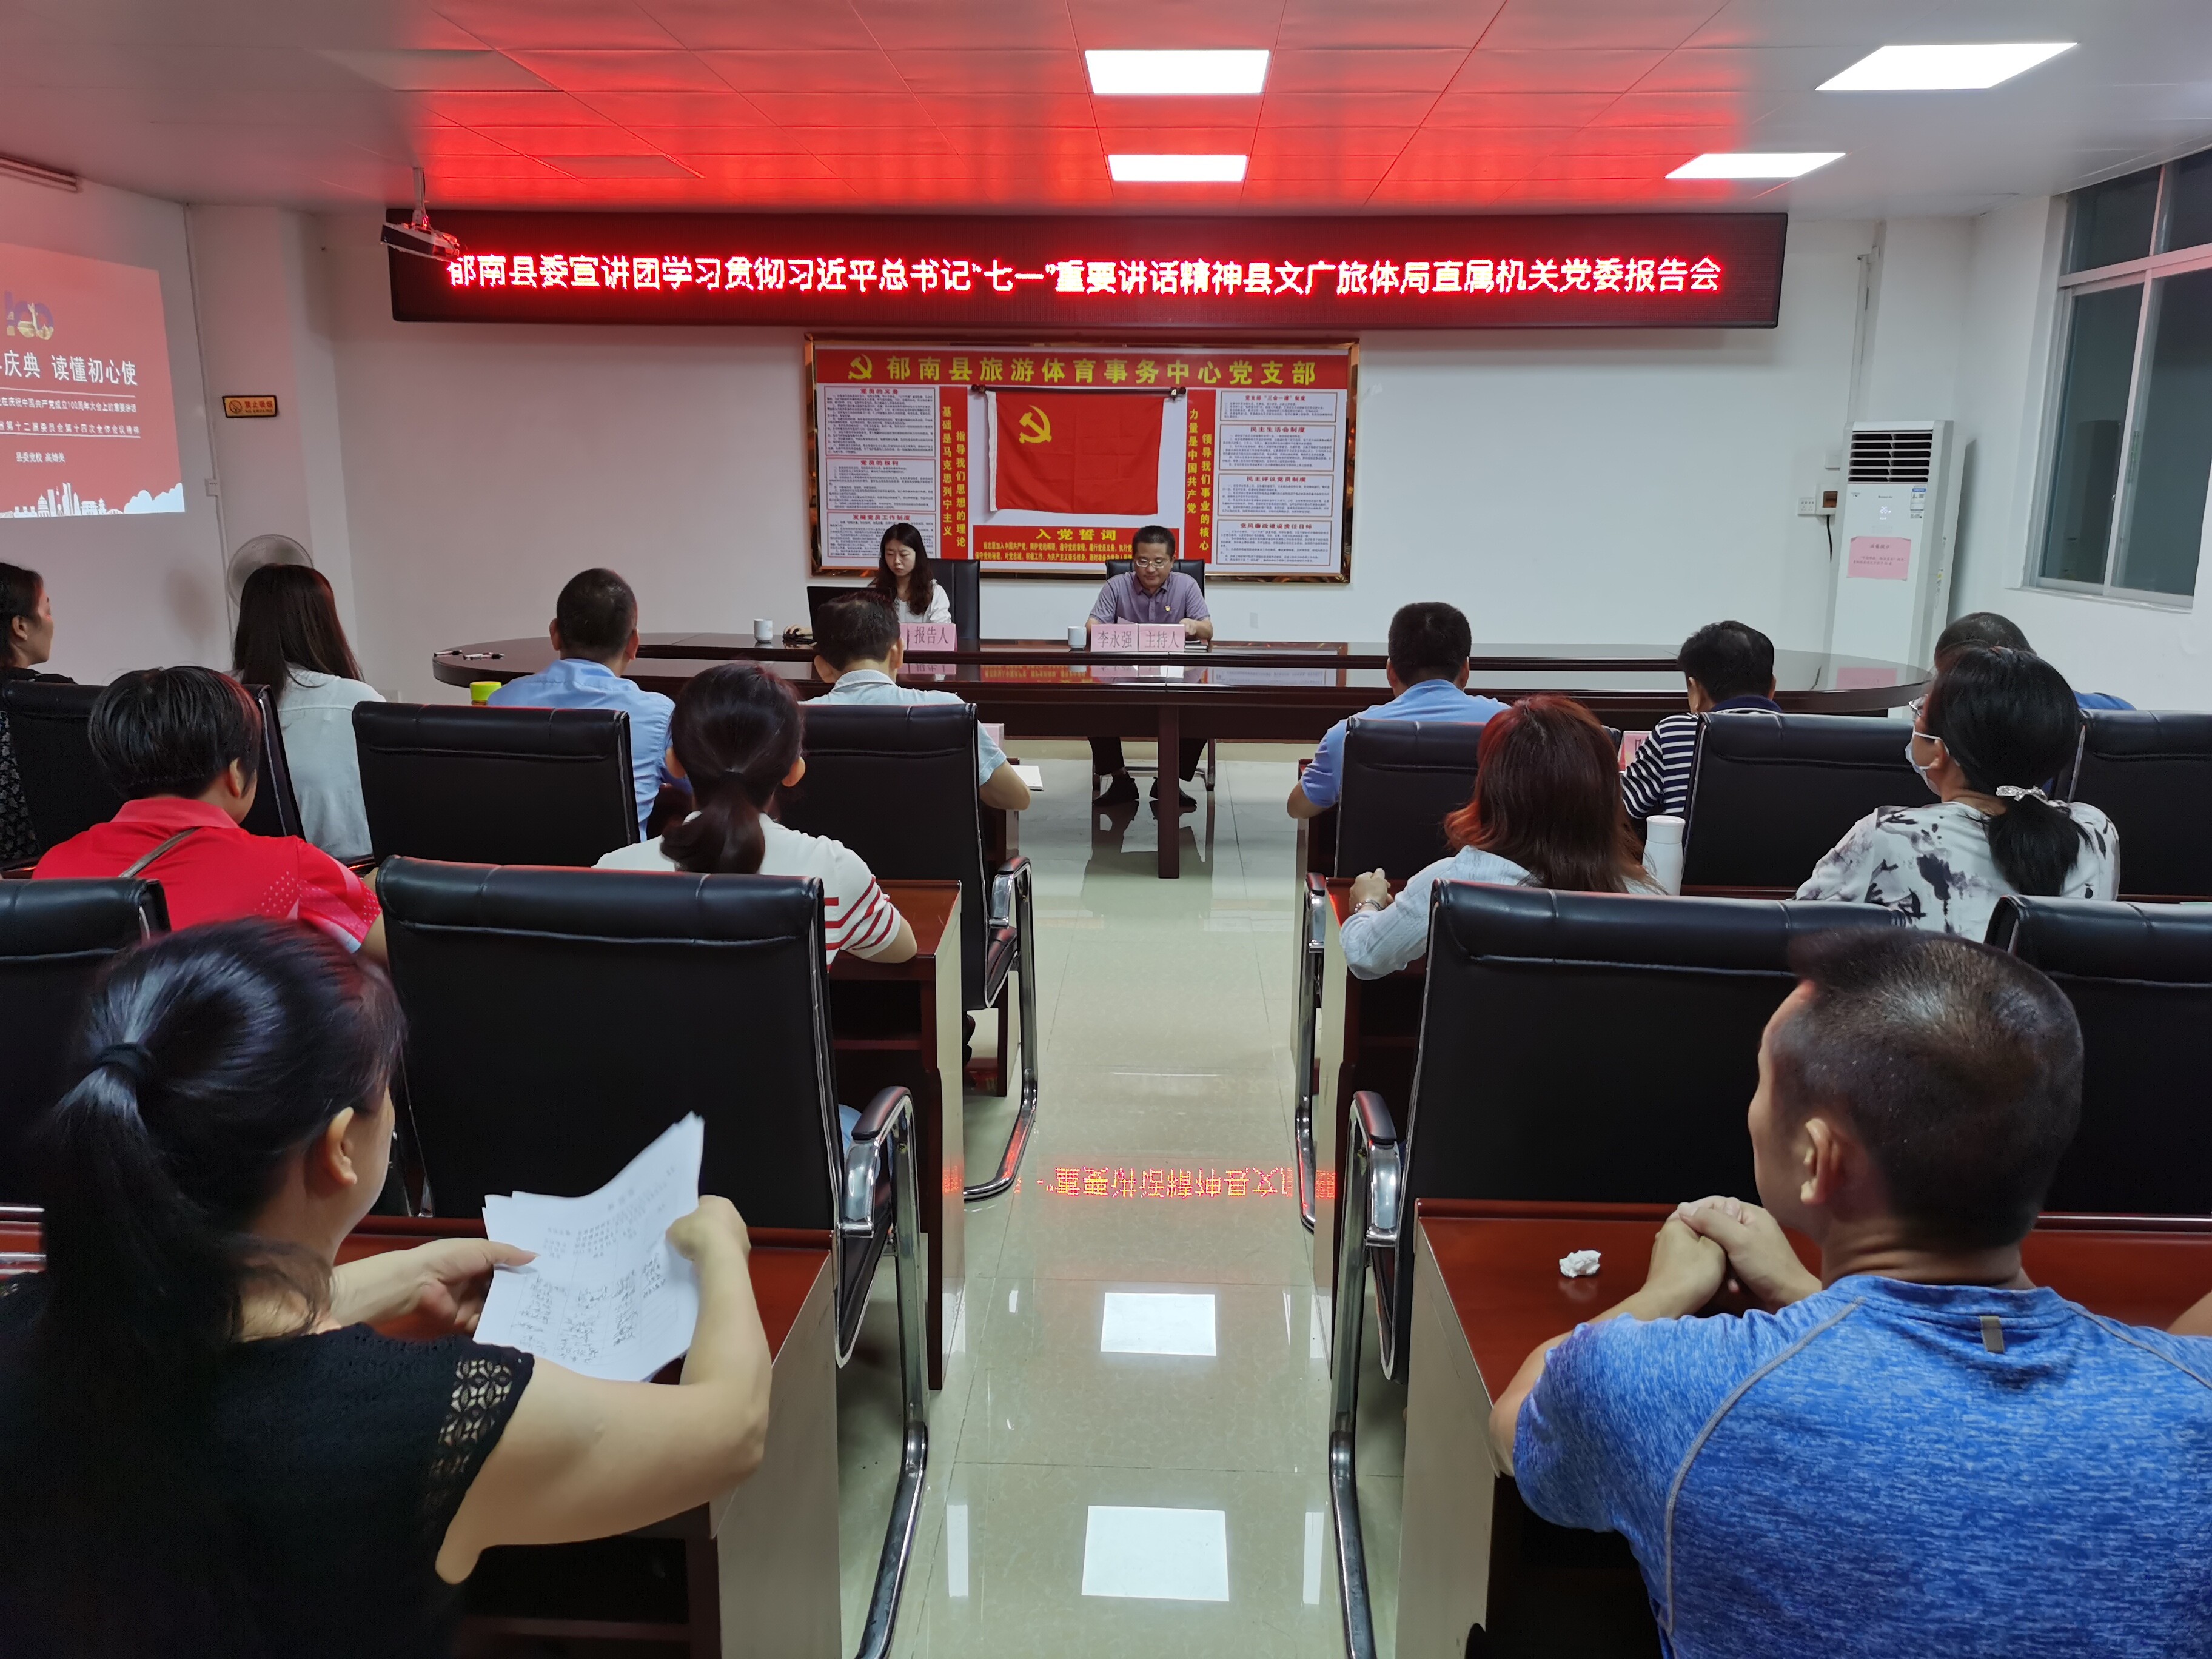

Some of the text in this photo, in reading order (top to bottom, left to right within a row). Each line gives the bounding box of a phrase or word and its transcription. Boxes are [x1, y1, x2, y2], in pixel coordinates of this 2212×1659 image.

[0, 349, 138, 386] 庆典 读懂初心使
[887, 356, 1316, 386] 郁南县旅游体育事务中心党支部
[0, 397, 136, 413] 在庆祝中国共产党成立100周年大会上的重要讲话
[942, 406, 953, 537] 基础是马克思列宁主义
[1186, 409, 1199, 514] 力量是中国共产党
[956, 431, 966, 548] 指导我们思想的理论
[1199, 434, 1212, 551] 领导我们事业的核心
[1036, 528, 1116, 541] 入党誓词
[914, 626, 948, 644] 报告人
[1098, 631, 1179, 648] 李永强 主持人
